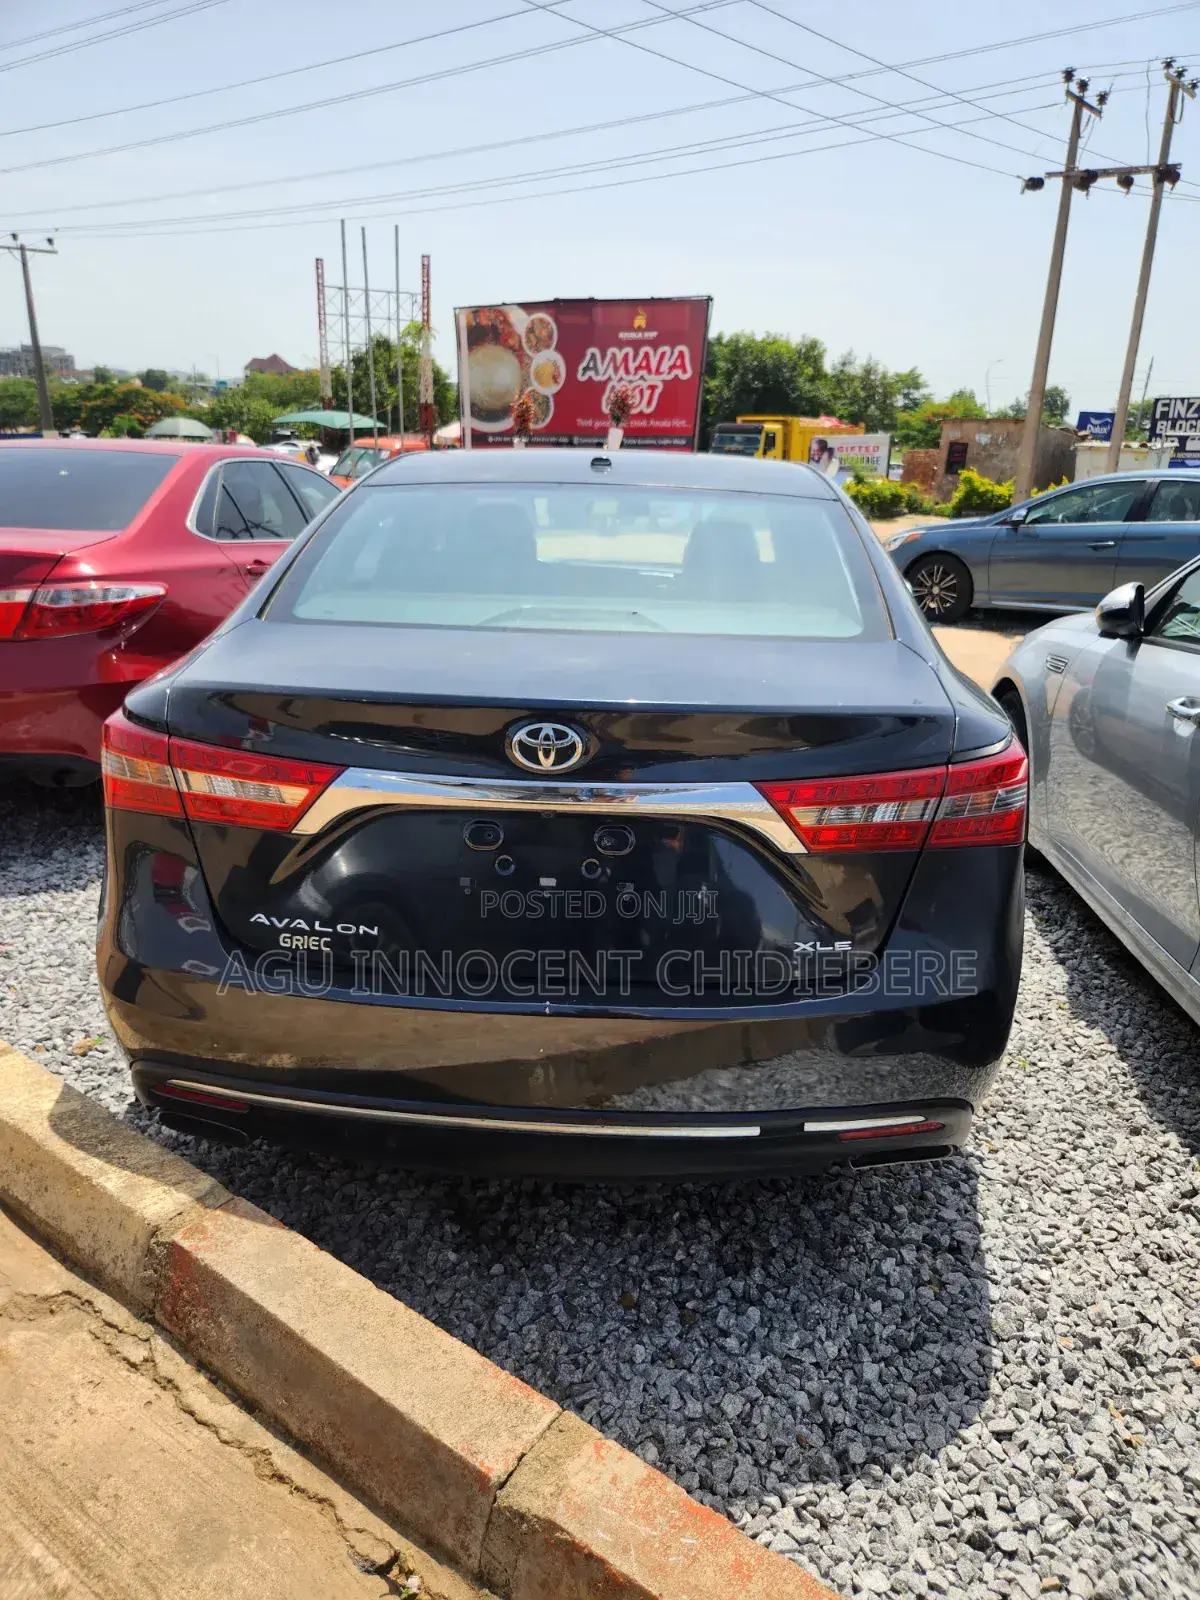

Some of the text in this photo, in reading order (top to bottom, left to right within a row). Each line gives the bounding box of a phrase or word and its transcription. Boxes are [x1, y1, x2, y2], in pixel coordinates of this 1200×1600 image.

[577, 345, 692, 382] AMALA
[837, 445, 880, 453] GIFTED
[249, 913, 379, 936] AVALON
[279, 933, 331, 951] GRIEC
[793, 940, 852, 951] XLE
